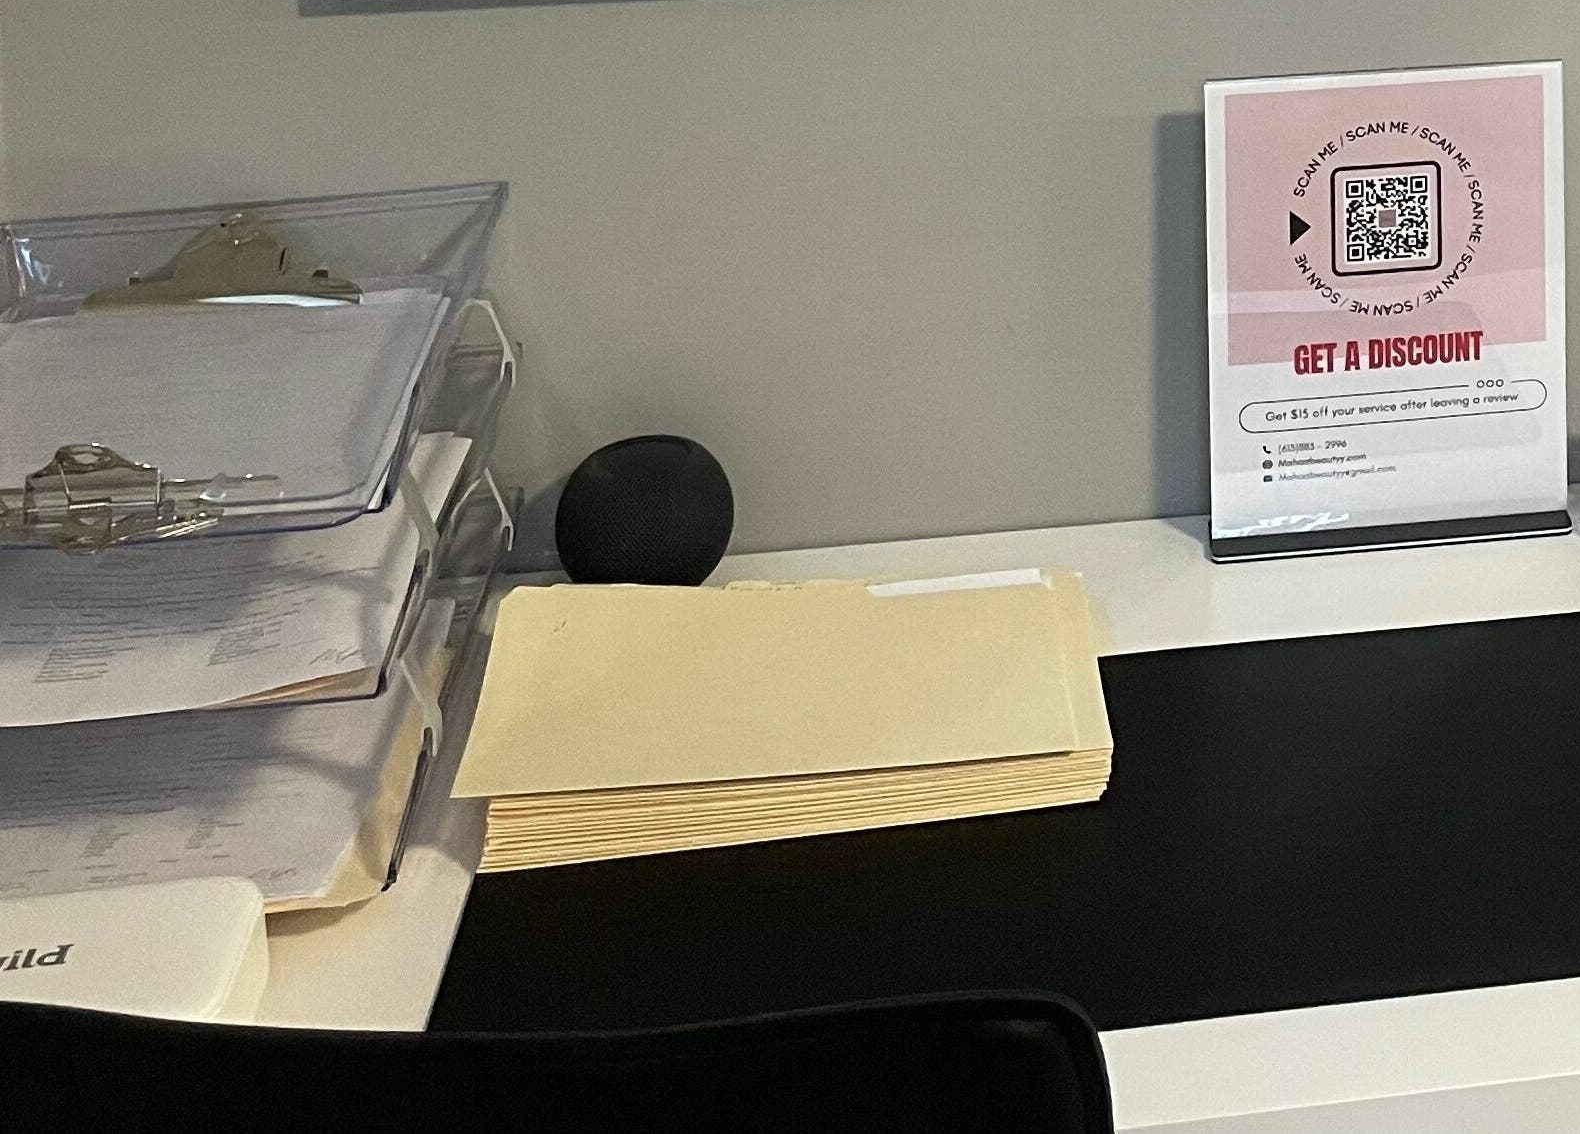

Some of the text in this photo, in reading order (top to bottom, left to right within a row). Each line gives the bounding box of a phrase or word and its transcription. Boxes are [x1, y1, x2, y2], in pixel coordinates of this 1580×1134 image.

[1293, 121, 1484, 316] SCAN ME SCAN ME SCAN ME SCAN ME SCAN ME SCAN ME SCAN ME
[1294, 330, 1484, 376] GET A DISCOUNT
[1265, 392, 1519, 422] Get $15 off your service after leaving a review
[1324, 439, 1348, 450] 2996
